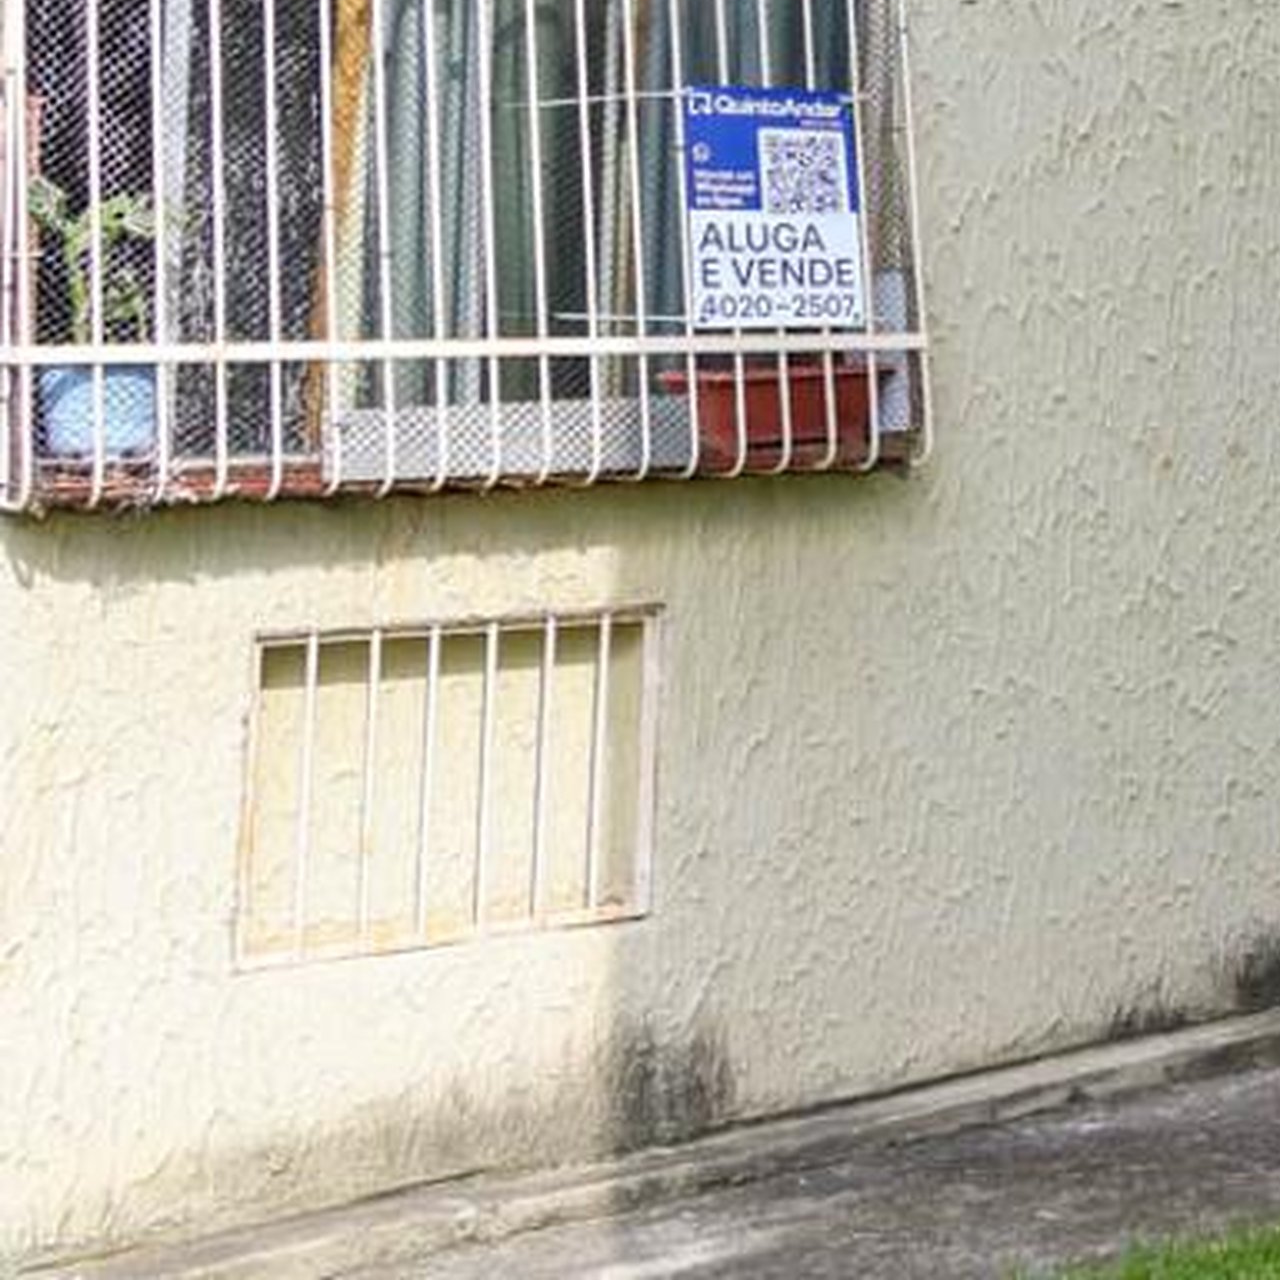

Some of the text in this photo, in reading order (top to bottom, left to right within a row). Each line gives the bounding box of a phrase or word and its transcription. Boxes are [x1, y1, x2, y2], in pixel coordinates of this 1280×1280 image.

[714, 94, 841, 118] QuintoAndar
[698, 222, 826, 253] ALUGA
[701, 258, 855, 288] E VENDE
[700, 293, 855, 319] 4020-2507
